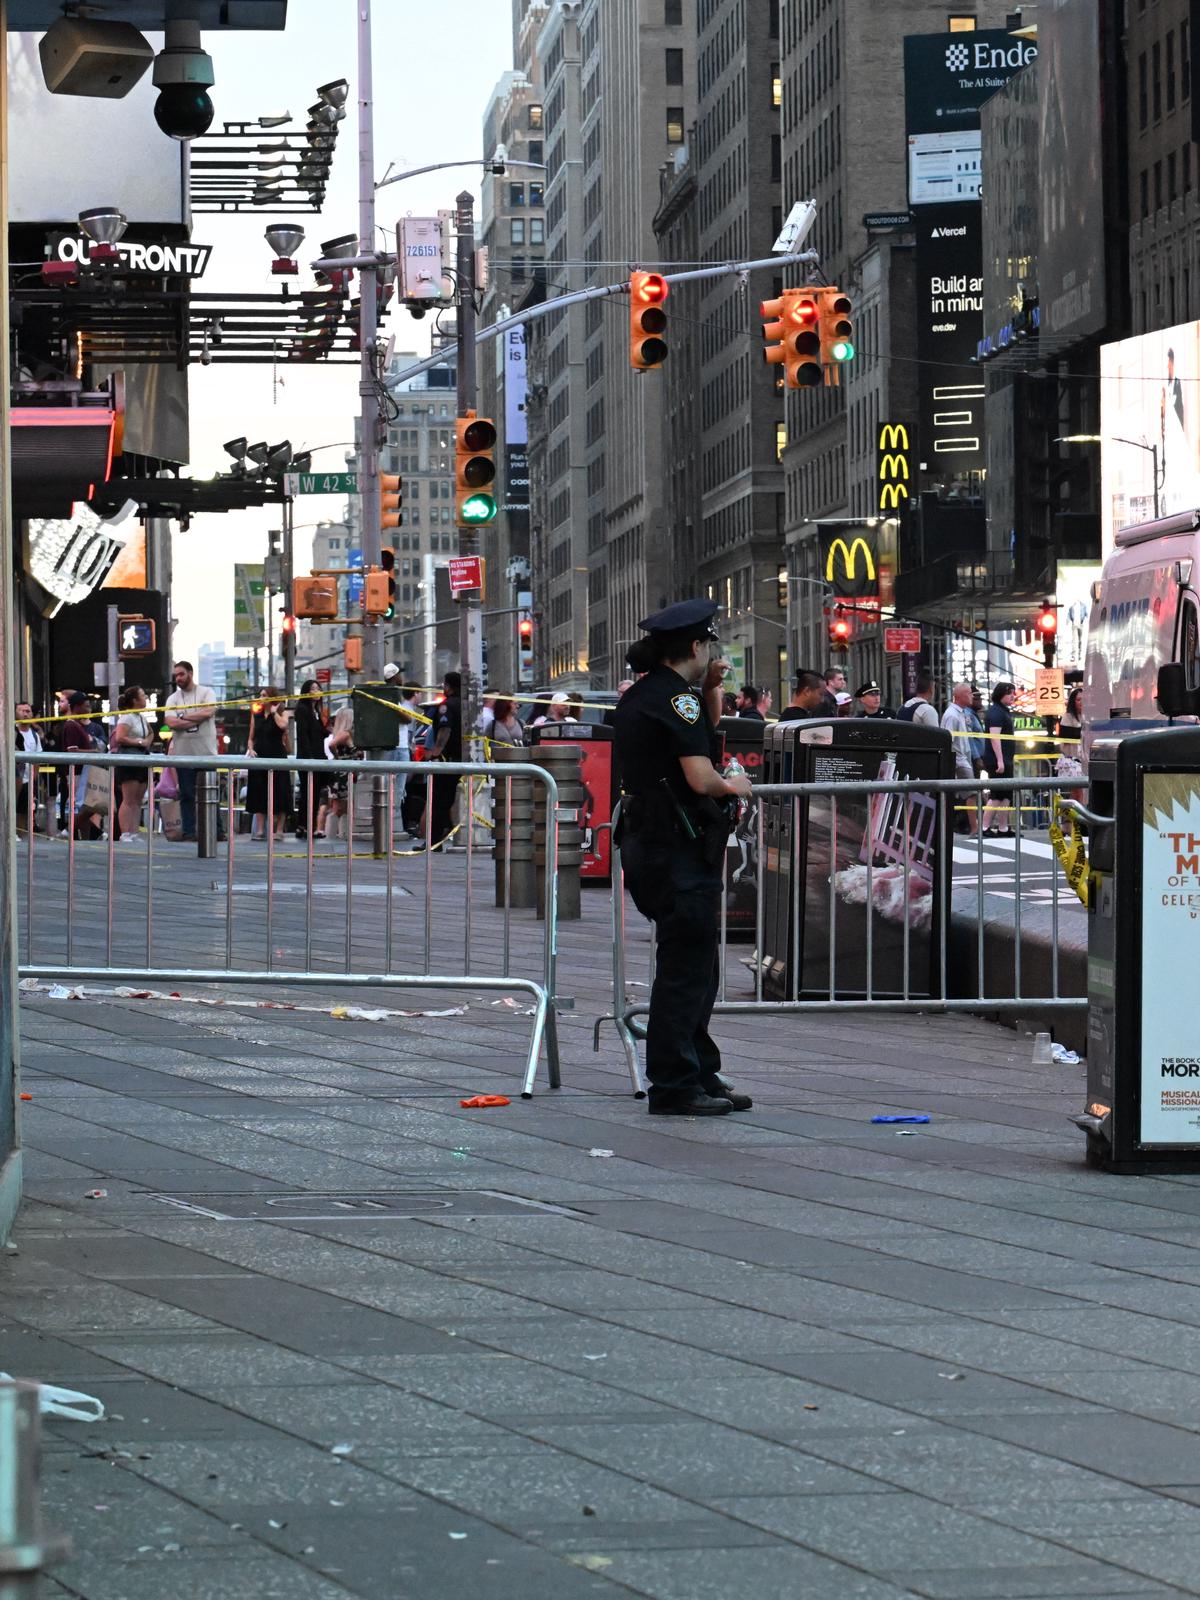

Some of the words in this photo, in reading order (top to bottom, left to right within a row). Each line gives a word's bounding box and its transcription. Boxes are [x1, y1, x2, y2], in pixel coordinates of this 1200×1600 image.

[959, 79, 973, 88] The
[975, 79, 984, 88] AI
[985, 77, 1005, 87] Suite
[938, 226, 967, 237] Vercel
[407, 245, 437, 257] 726151
[931, 275, 966, 295] Build
[931, 297, 944, 314] in
[932, 323, 957, 333] eve.dev
[509, 348, 522, 362] is
[302, 476, 316, 492] W
[322, 475, 340, 492] 42
[345, 475, 357, 486] St
[1040, 686, 1060, 700] 25
[1167, 876, 1190, 887] OF
